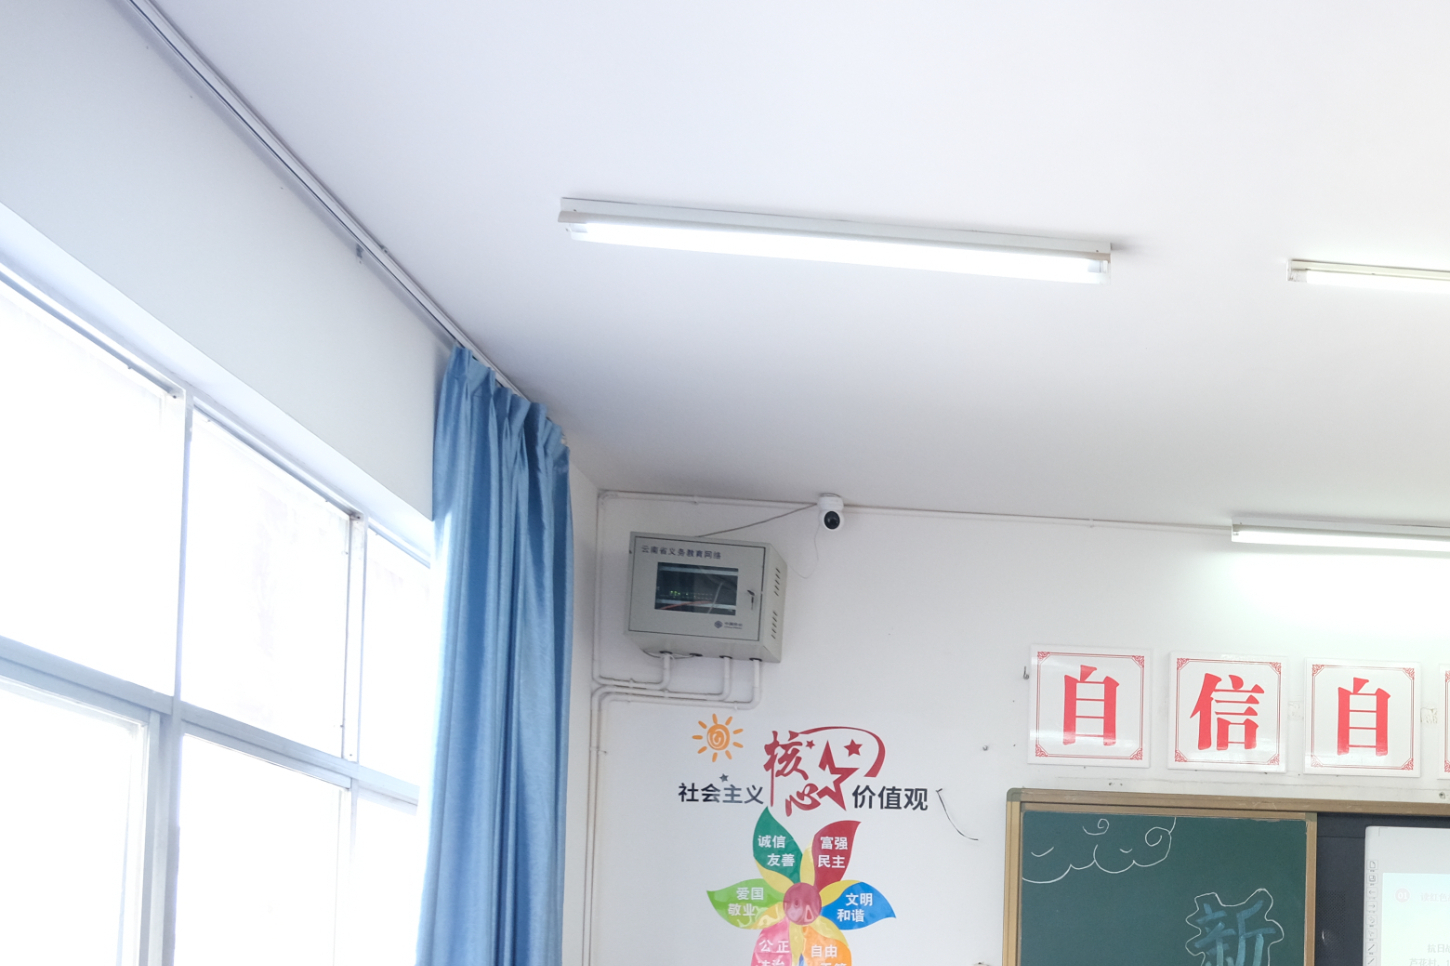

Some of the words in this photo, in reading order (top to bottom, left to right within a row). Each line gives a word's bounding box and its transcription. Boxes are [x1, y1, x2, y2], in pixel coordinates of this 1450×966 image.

[677, 783, 764, 805] 社会主义
[763, 725, 886, 817] 核心
[852, 784, 928, 811] 价值观
[757, 835, 786, 849] 诚信
[820, 836, 848, 850] 富强
[767, 853, 795, 868] 友善
[817, 854, 845, 869] 民主
[736, 887, 764, 901] 爱国
[845, 892, 873, 907] 文明
[727, 903, 756, 917] 敬业
[836, 908, 865, 923] 和谐
[758, 939, 790, 954] 公正
[810, 945, 838, 959] 自由
